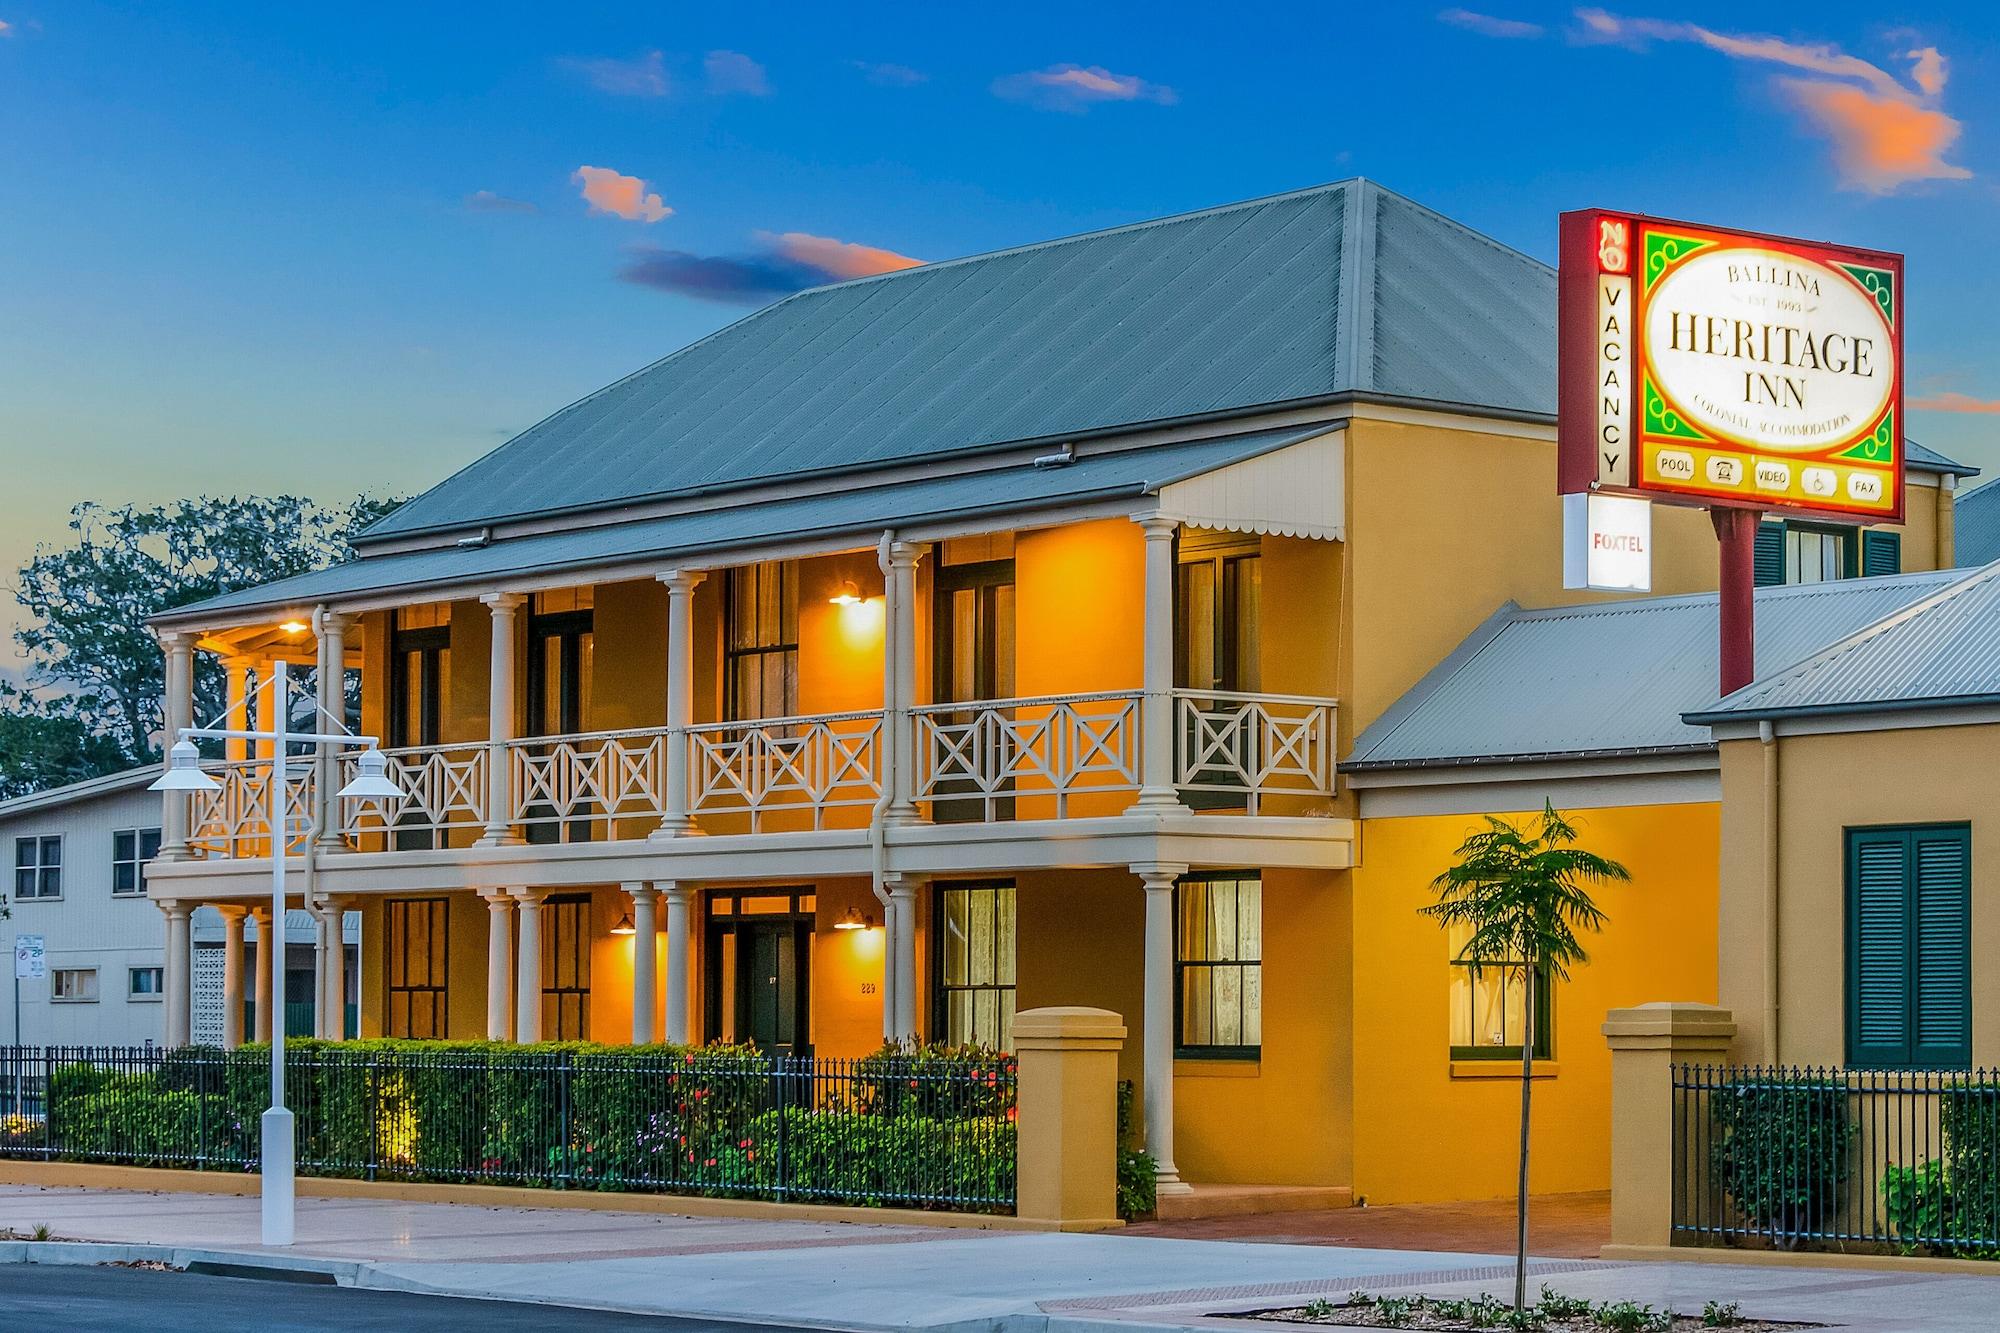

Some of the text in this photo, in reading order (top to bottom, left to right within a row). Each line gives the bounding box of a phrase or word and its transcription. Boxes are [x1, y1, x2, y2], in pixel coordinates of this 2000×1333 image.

[1727, 264, 1821, 297] BALLINA
[1777, 299, 1801, 312] 1993
[1599, 220, 1625, 474] NO VACANCY
[1668, 311, 1874, 378] HERITAGE
[1743, 371, 1807, 410] INN
[1694, 393, 1751, 430] COLONIAL
[1660, 457, 1691, 473] POOL
[1757, 469, 1787, 484] VIDEO
[1854, 480, 1875, 494] FAX
[1594, 532, 1643, 553] FOXTEL
[861, 983, 876, 994] 229
